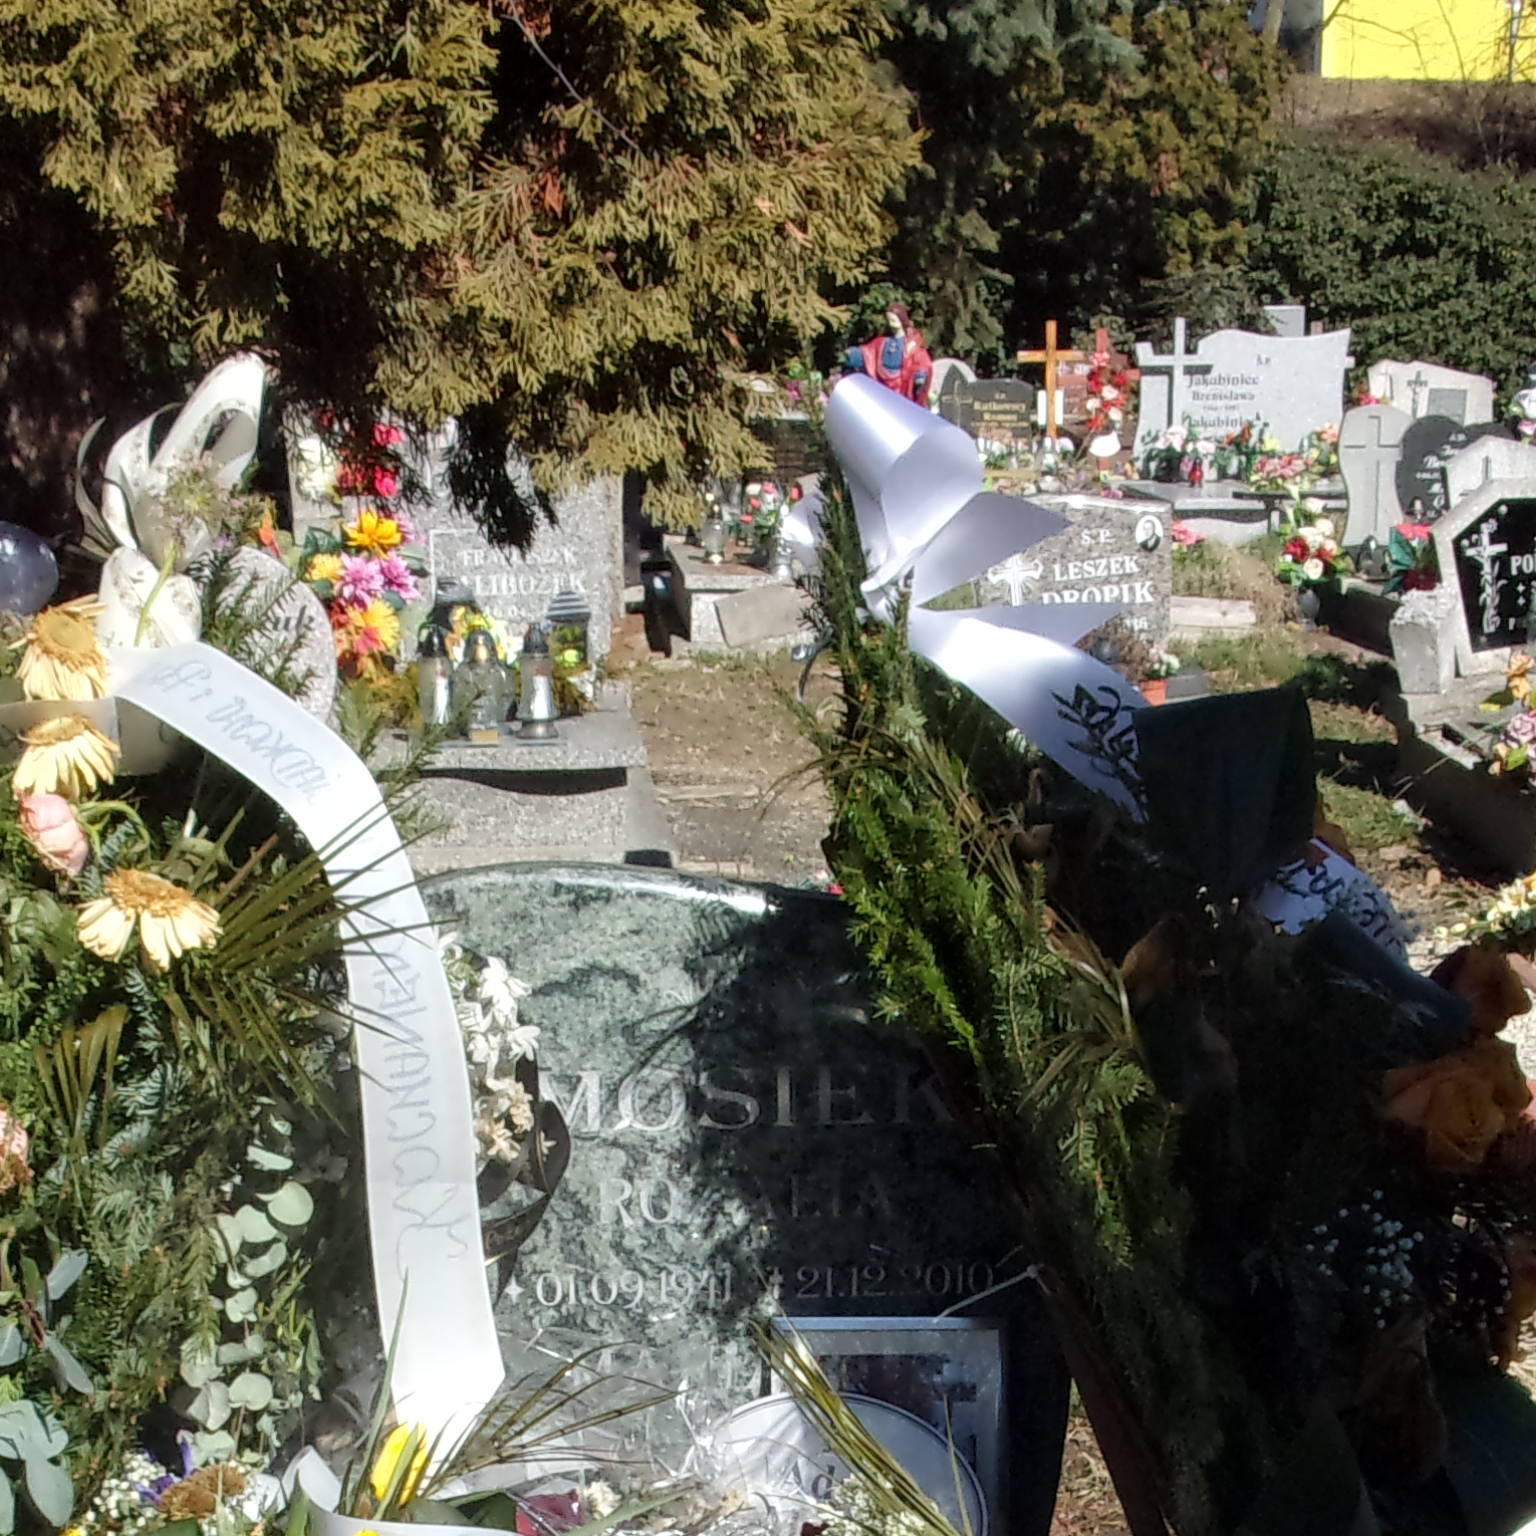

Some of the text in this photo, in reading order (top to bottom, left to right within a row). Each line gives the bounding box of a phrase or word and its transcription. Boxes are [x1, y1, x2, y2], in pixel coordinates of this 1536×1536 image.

[1054, 555, 1141, 582] LESZEK
[1042, 580, 1155, 605] DROPIK
[598, 1172, 892, 1230] ROALIA
